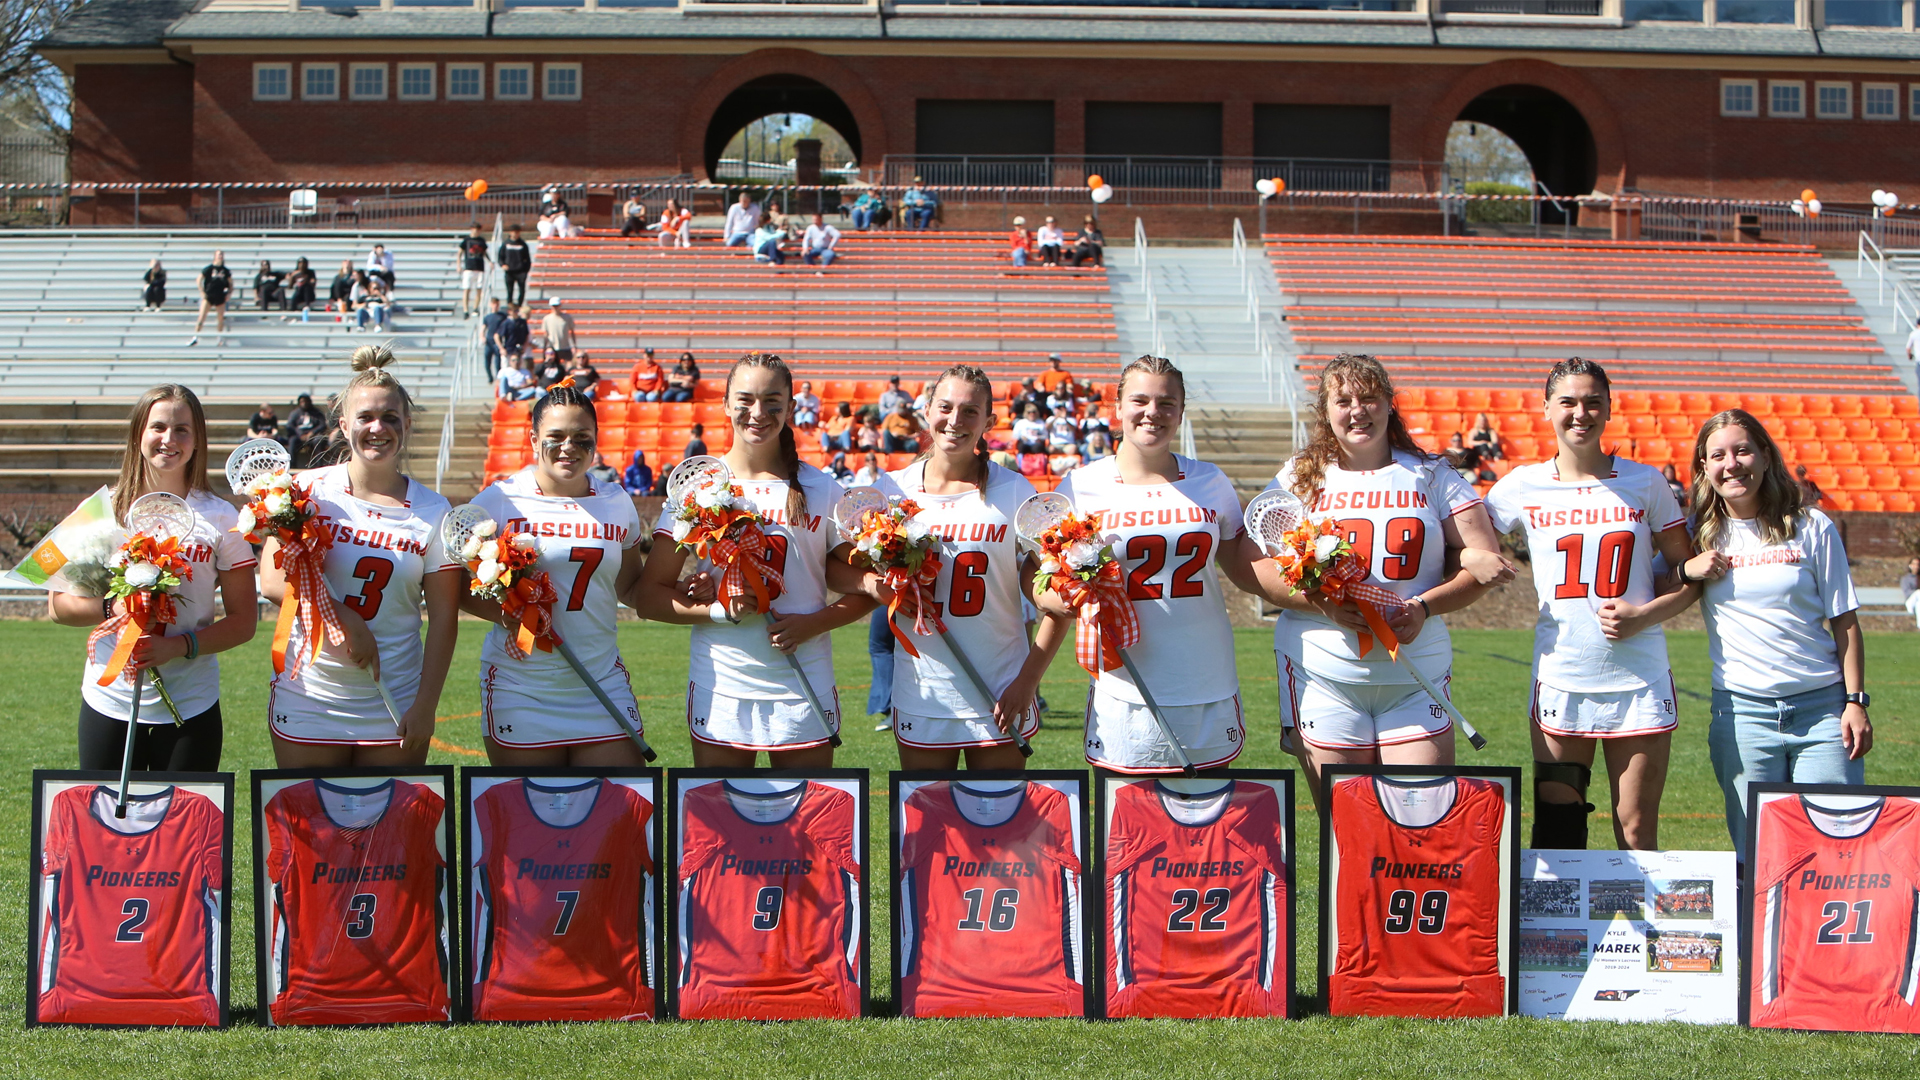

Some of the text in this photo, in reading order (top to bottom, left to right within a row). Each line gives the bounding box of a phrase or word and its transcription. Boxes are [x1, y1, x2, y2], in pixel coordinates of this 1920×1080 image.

[1523, 505, 1645, 529] TUSCULUM
[507, 517, 627, 543] TUSCULUM
[930, 523, 1008, 543] CULUM
[1336, 516, 1426, 580] 99
[1756, 549, 1802, 566] LACROSSE
[1126, 532, 1212, 600] 22
[1555, 531, 1635, 599] 10
[343, 556, 394, 621] 3
[566, 547, 604, 611] 7
[1429, 704, 1442, 718] TU
[1227, 727, 1237, 742] TU
[86, 865, 181, 887] PIONEERS
[312, 863, 407, 884] PIONEERS
[517, 858, 611, 879] PIONEERS
[720, 854, 813, 876] PIONEERS
[943, 856, 1036, 877] PIONEERS
[1151, 858, 1244, 878] PIONEERS
[1370, 857, 1463, 879] PIONEERS
[1799, 870, 1891, 890] PIONEERS
[115, 898, 149, 942] 2
[346, 893, 377, 939] 3
[553, 891, 580, 935] 7
[752, 886, 783, 931] 9
[957, 888, 1019, 932] 16
[1167, 887, 1230, 932] 22
[1385, 889, 1449, 935] 99
[1816, 900, 1874, 944] 21
[1593, 944, 1641, 953] MAREK
[1662, 959, 1674, 969] TU
[1617, 990, 1628, 1001] TU
